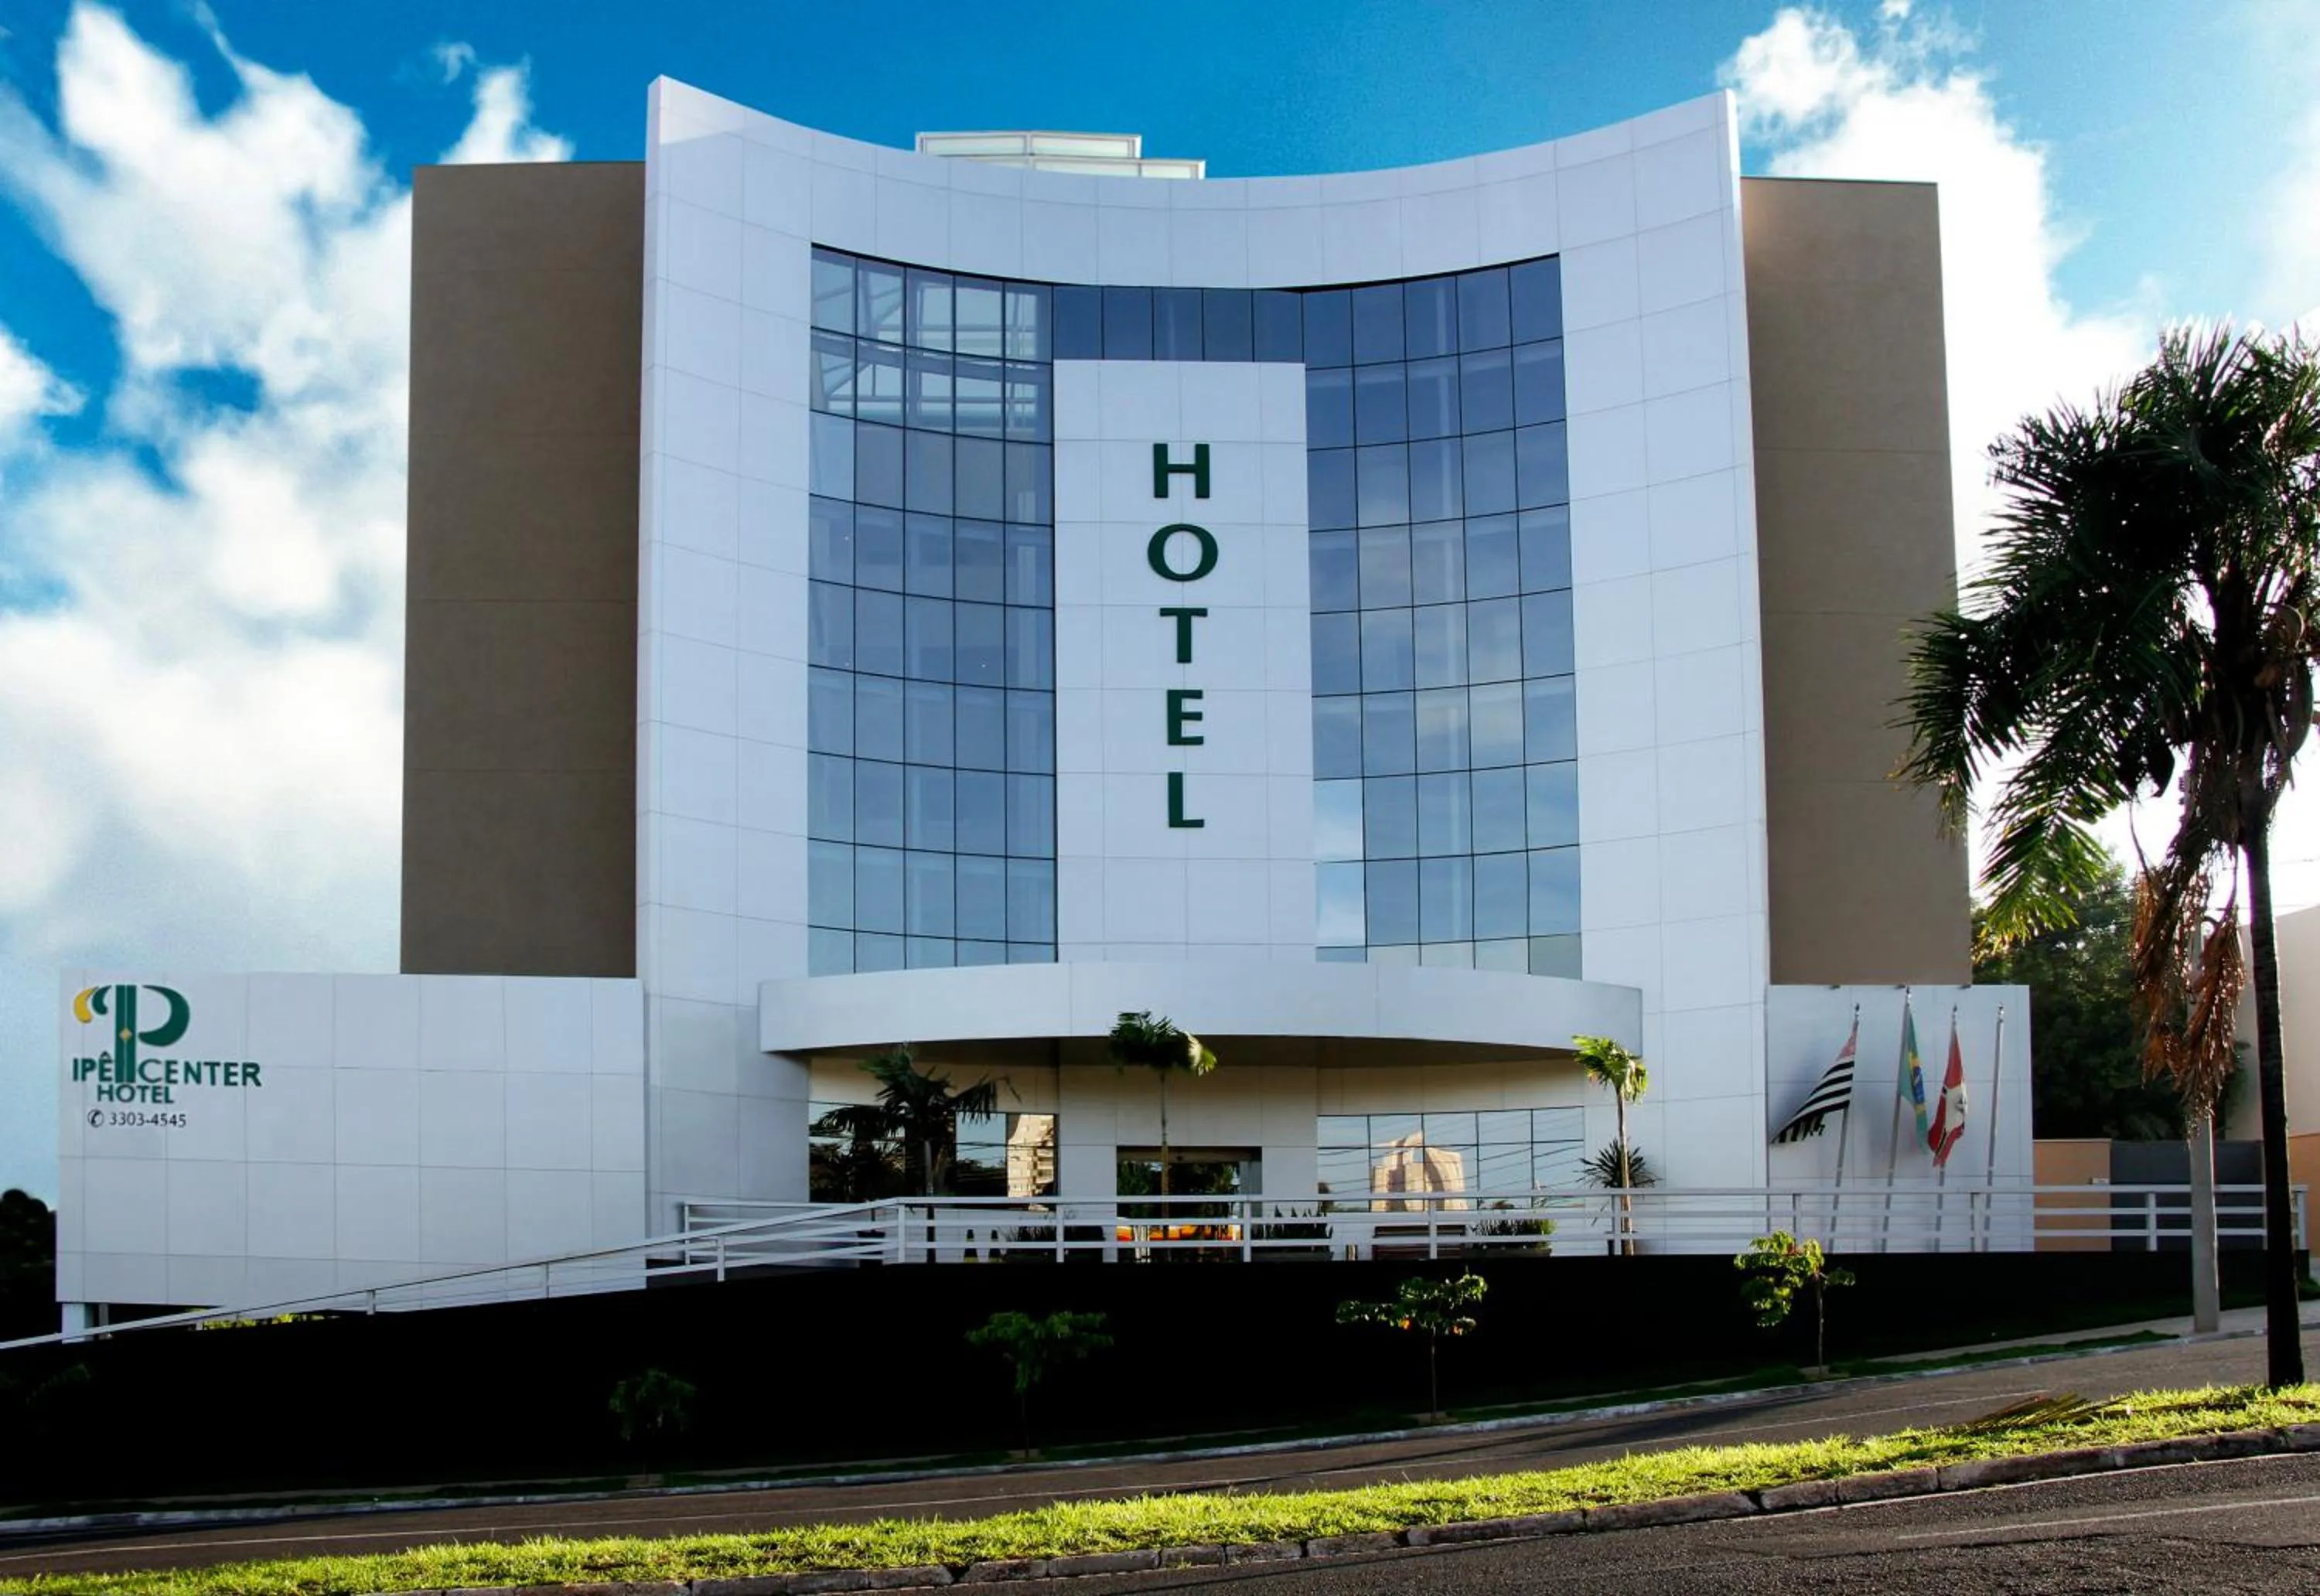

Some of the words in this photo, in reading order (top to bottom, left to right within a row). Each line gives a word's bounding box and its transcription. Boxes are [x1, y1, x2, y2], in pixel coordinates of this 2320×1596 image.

[1148, 443, 1218, 828] HOTEL
[73, 1050, 114, 1083] IPÊ
[138, 1058, 262, 1086] CENTER
[97, 1084, 175, 1104] HOTEL
[108, 1112, 186, 1127] 3303-4545
